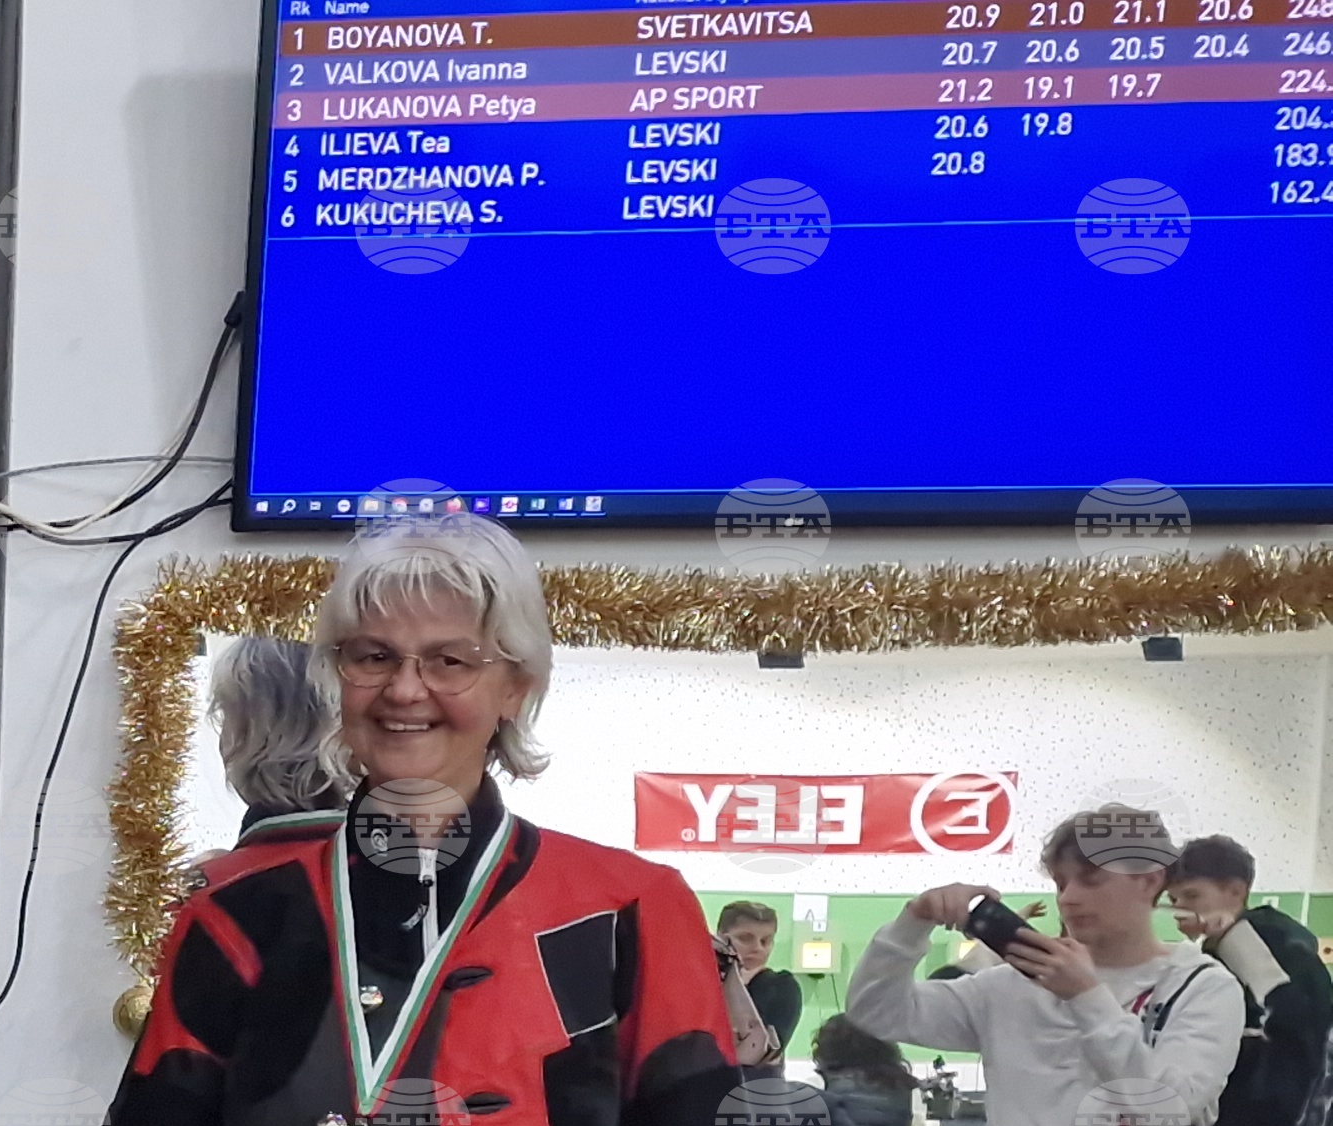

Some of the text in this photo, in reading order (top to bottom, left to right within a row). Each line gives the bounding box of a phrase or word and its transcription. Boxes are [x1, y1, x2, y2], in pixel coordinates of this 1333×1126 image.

[290, 0, 370, 16] Rk Name
[294, 28, 303, 50] 1
[327, 22, 466, 49] BOYANOVA
[471, 21, 493, 44] T.
[637, 10, 813, 38] SVETKAVITSA
[946, 4, 1000, 28] 20.9
[1029, 2, 1084, 26] 21.0
[1113, 0, 1165, 23] 21.1
[1198, 0, 1253, 21] 20.6
[289, 64, 304, 86] 2
[324, 60, 440, 85] VALKOVA
[447, 59, 527, 82] Ivanna
[635, 50, 727, 75] LEVSKI
[942, 41, 997, 65] 20.7
[1025, 39, 1079, 63] 20.6
[1109, 36, 1165, 60] 20.5
[1193, 33, 1249, 58] 20.4
[287, 100, 302, 121] 3
[323, 95, 462, 120] LUKANOVA
[468, 94, 536, 122] Petya
[629, 88, 667, 112] AP
[672, 85, 764, 110] SPORT
[938, 78, 993, 102] 21.2
[1024, 75, 1074, 99] 19.1
[1109, 73, 1161, 98] 19.7
[284, 106, 1333, 157] 4 ILIEVA Tea LEVSKI 20.6 19.8 204.
[283, 170, 297, 192] 5
[318, 165, 514, 191] MERDZHANOVA
[521, 162, 546, 187] P.
[625, 158, 717, 184] LEVSKI
[931, 151, 985, 175] 20.8
[281, 206, 295, 227] 6
[316, 201, 474, 226] KUKUCHEVA
[479, 201, 503, 223] S.
[622, 194, 714, 220] LEVSKI
